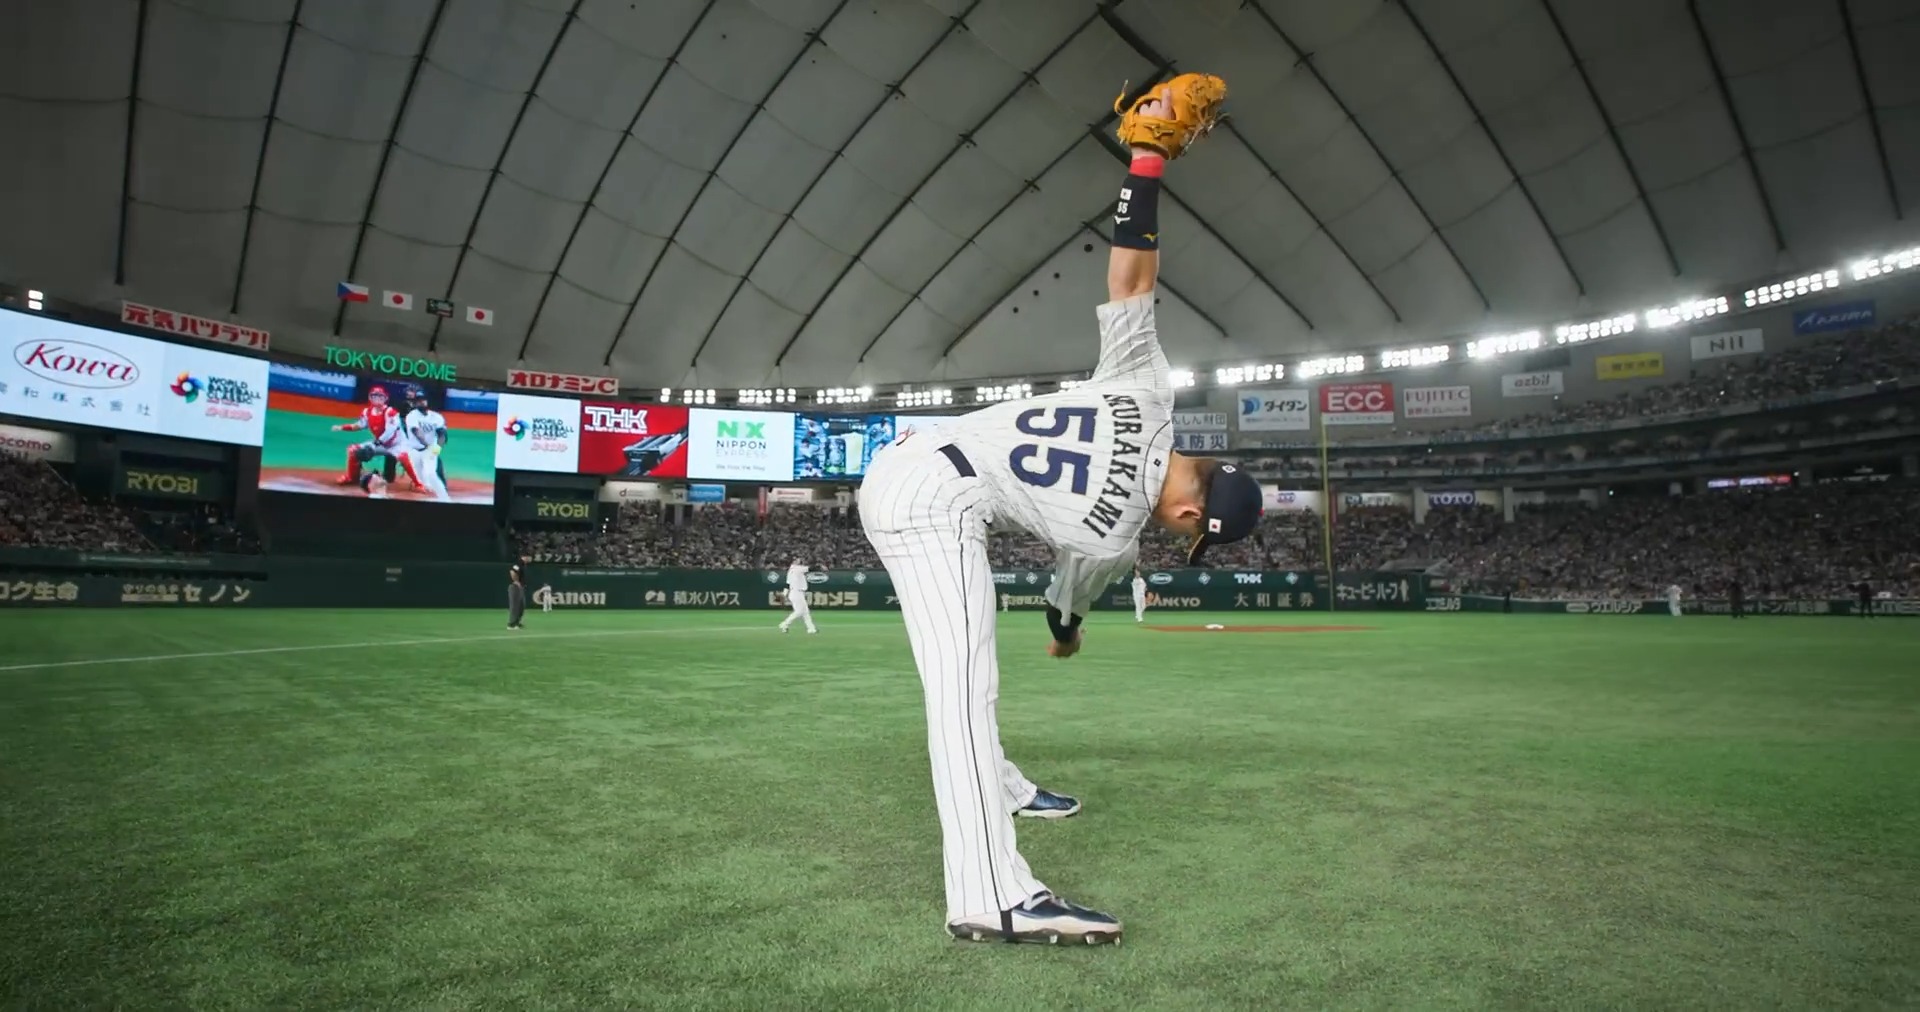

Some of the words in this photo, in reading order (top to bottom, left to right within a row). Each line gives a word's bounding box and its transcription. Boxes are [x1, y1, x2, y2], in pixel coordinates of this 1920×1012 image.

[1117, 201, 1128, 214] 55
[125, 304, 267, 348] 元気ハツラツ!
[25, 343, 135, 381] Kowa
[324, 345, 396, 373] TOKYO
[400, 357, 457, 382] DOME
[510, 371, 616, 394] オロナミンC
[1328, 392, 1385, 410] ECC
[585, 406, 648, 430] THK
[717, 421, 764, 438] NX
[716, 440, 767, 450] NIPPON
[1009, 406, 1098, 496] 55
[1081, 394, 1143, 539] MURAKAMI
[127, 471, 198, 494] RYOBI
[1430, 492, 1474, 504] TOTO
[537, 503, 589, 518] RYOBI
[1234, 574, 1262, 584] THK
[183, 584, 250, 602] セノン
[533, 590, 606, 605] Canon
[674, 591, 741, 605] 積水ハウス
[1234, 592, 1314, 607] 大和証券
[1336, 583, 1398, 600] キューピーハーフ
